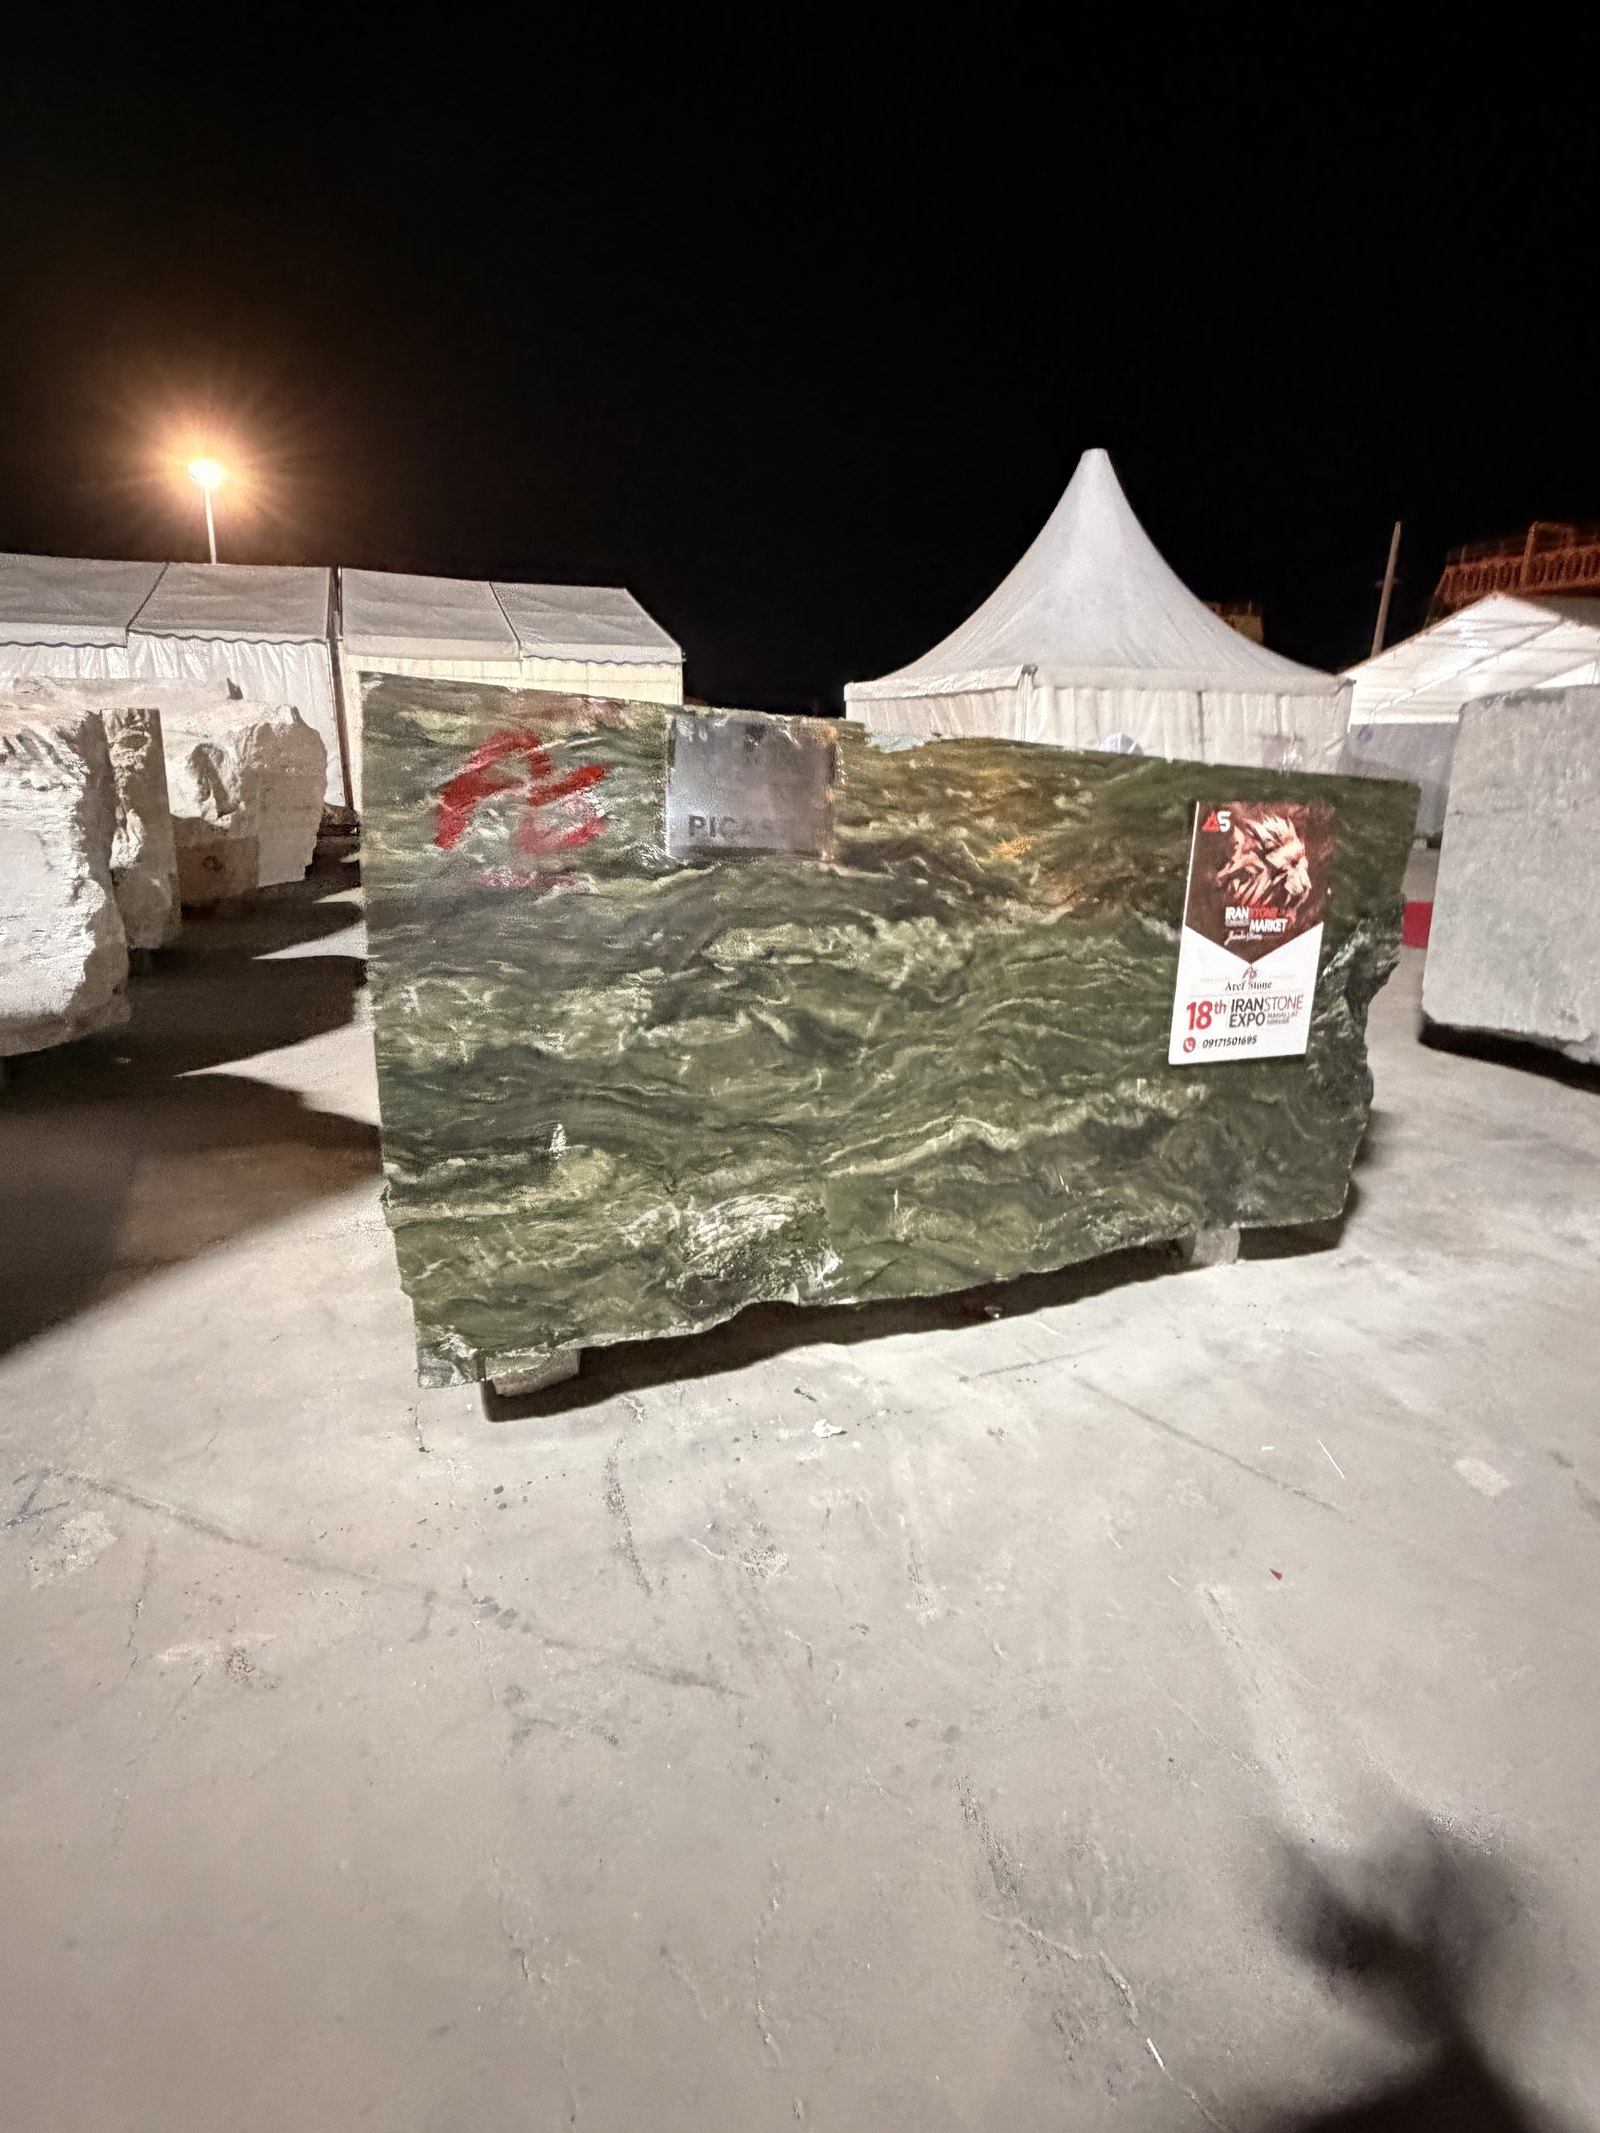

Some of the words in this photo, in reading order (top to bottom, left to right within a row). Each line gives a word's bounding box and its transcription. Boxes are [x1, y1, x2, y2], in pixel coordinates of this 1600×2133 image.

[1225, 906, 1249, 921] IRAN
[1249, 918, 1288, 933] MARKET
[1229, 1012, 1265, 1028] EXPO
